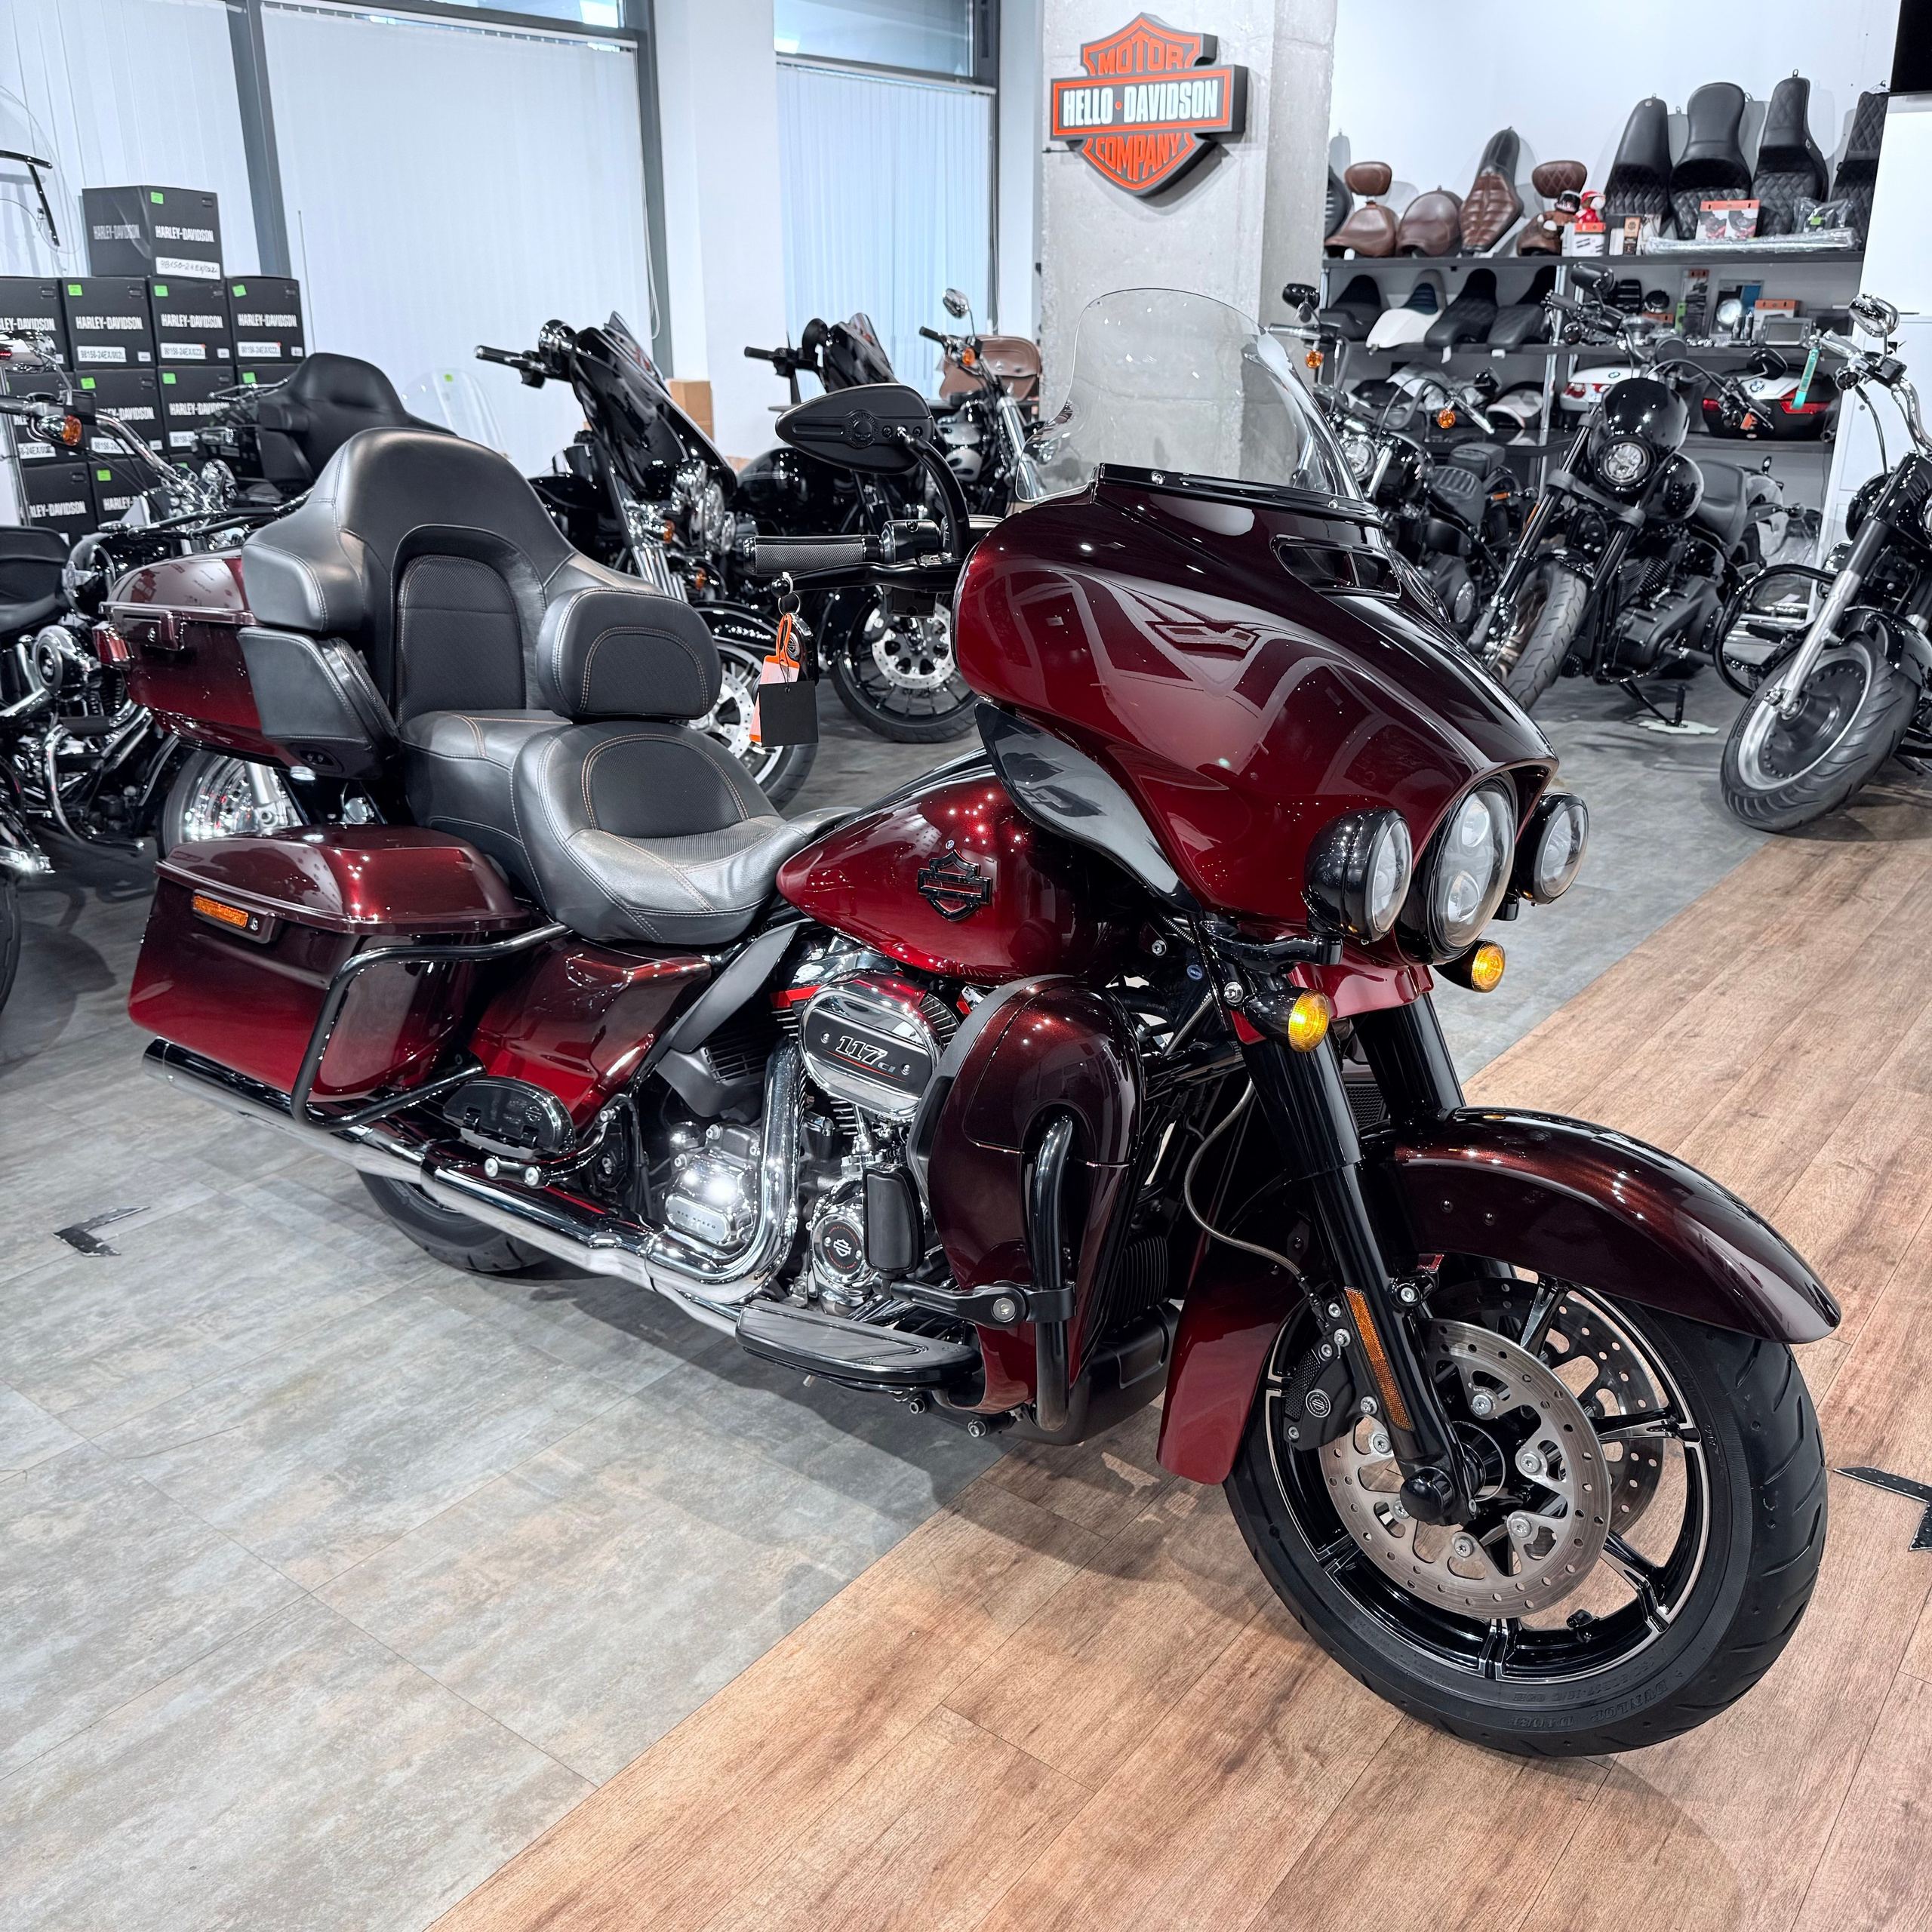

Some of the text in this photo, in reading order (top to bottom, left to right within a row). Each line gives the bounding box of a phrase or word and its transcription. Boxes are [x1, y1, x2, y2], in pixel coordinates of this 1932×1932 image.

[1098, 30, 1183, 75] MOTOR
[1063, 79, 1218, 127] HELLO DAVIDSON
[1096, 132, 1182, 182] COMPANY
[155, 225, 215, 243] HARLEY-DAVIDSON
[75, 315, 143, 330] HARLEY-DAVIDSON
[161, 314, 223, 328] HARLEY-DAVIDSON
[237, 313, 297, 328] HARLEY-DAVIDSON
[835, 1035, 897, 1073] 117 CI
[1590, 1678, 1668, 1723] DUNLOP
